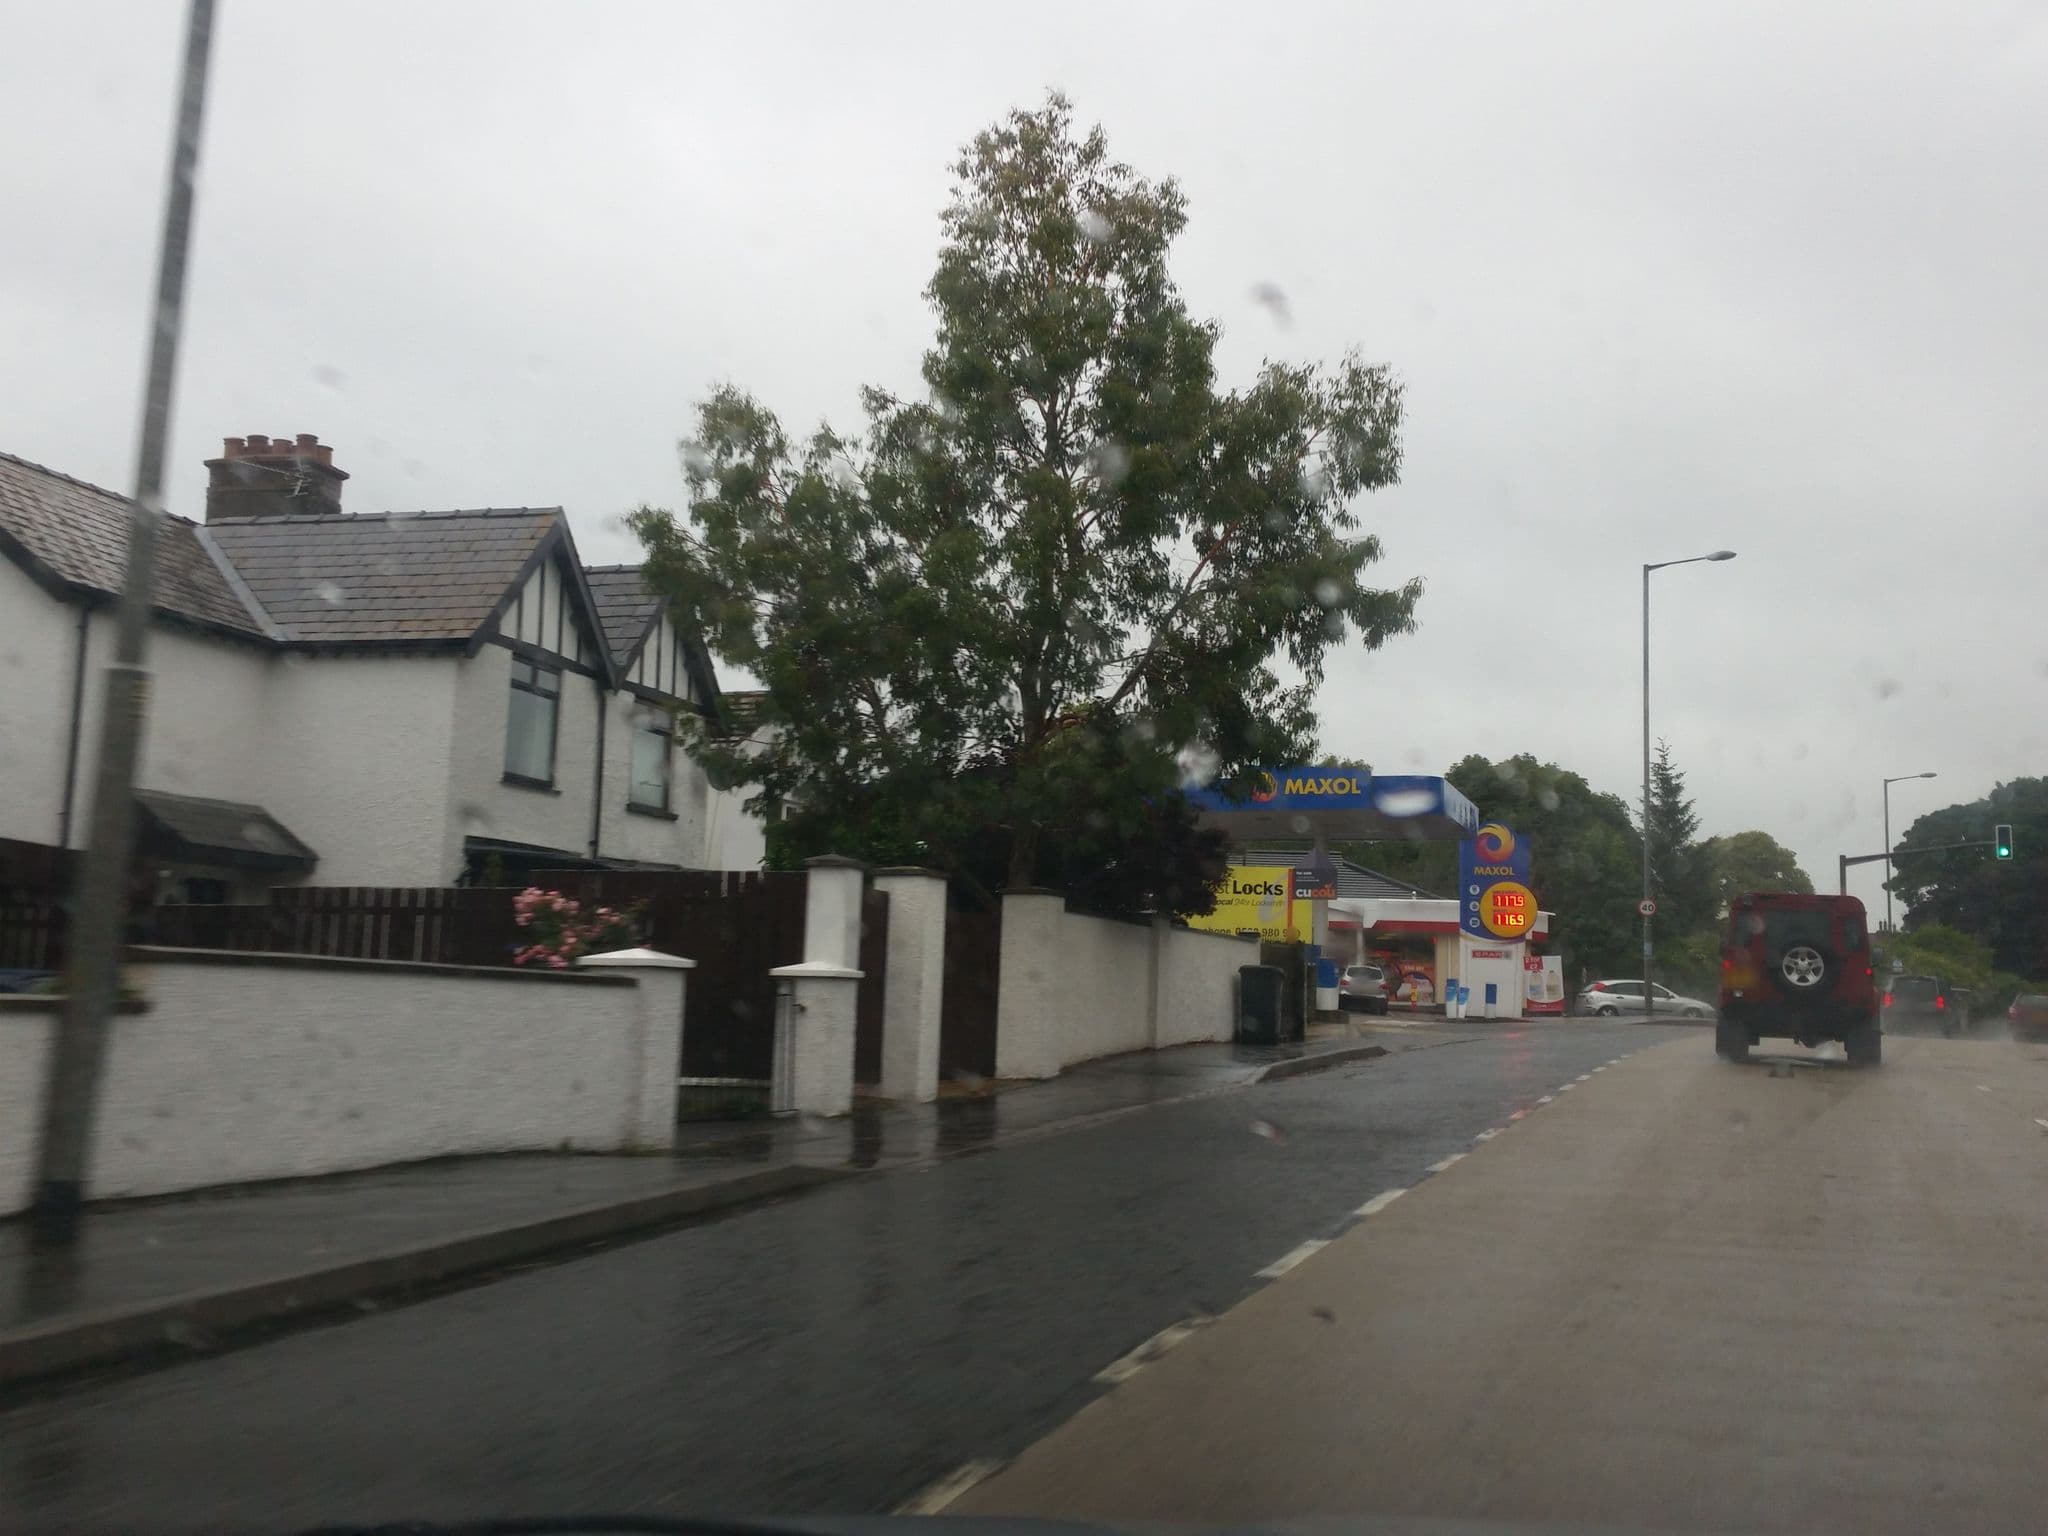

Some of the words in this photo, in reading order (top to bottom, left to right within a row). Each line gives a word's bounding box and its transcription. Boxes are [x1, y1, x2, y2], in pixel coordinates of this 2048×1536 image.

[1284, 777, 1361, 795] MAXOL
[1474, 866, 1516, 876] MAXOL
[1232, 879, 1284, 896] Locks
[1262, 928, 1280, 938] 980
